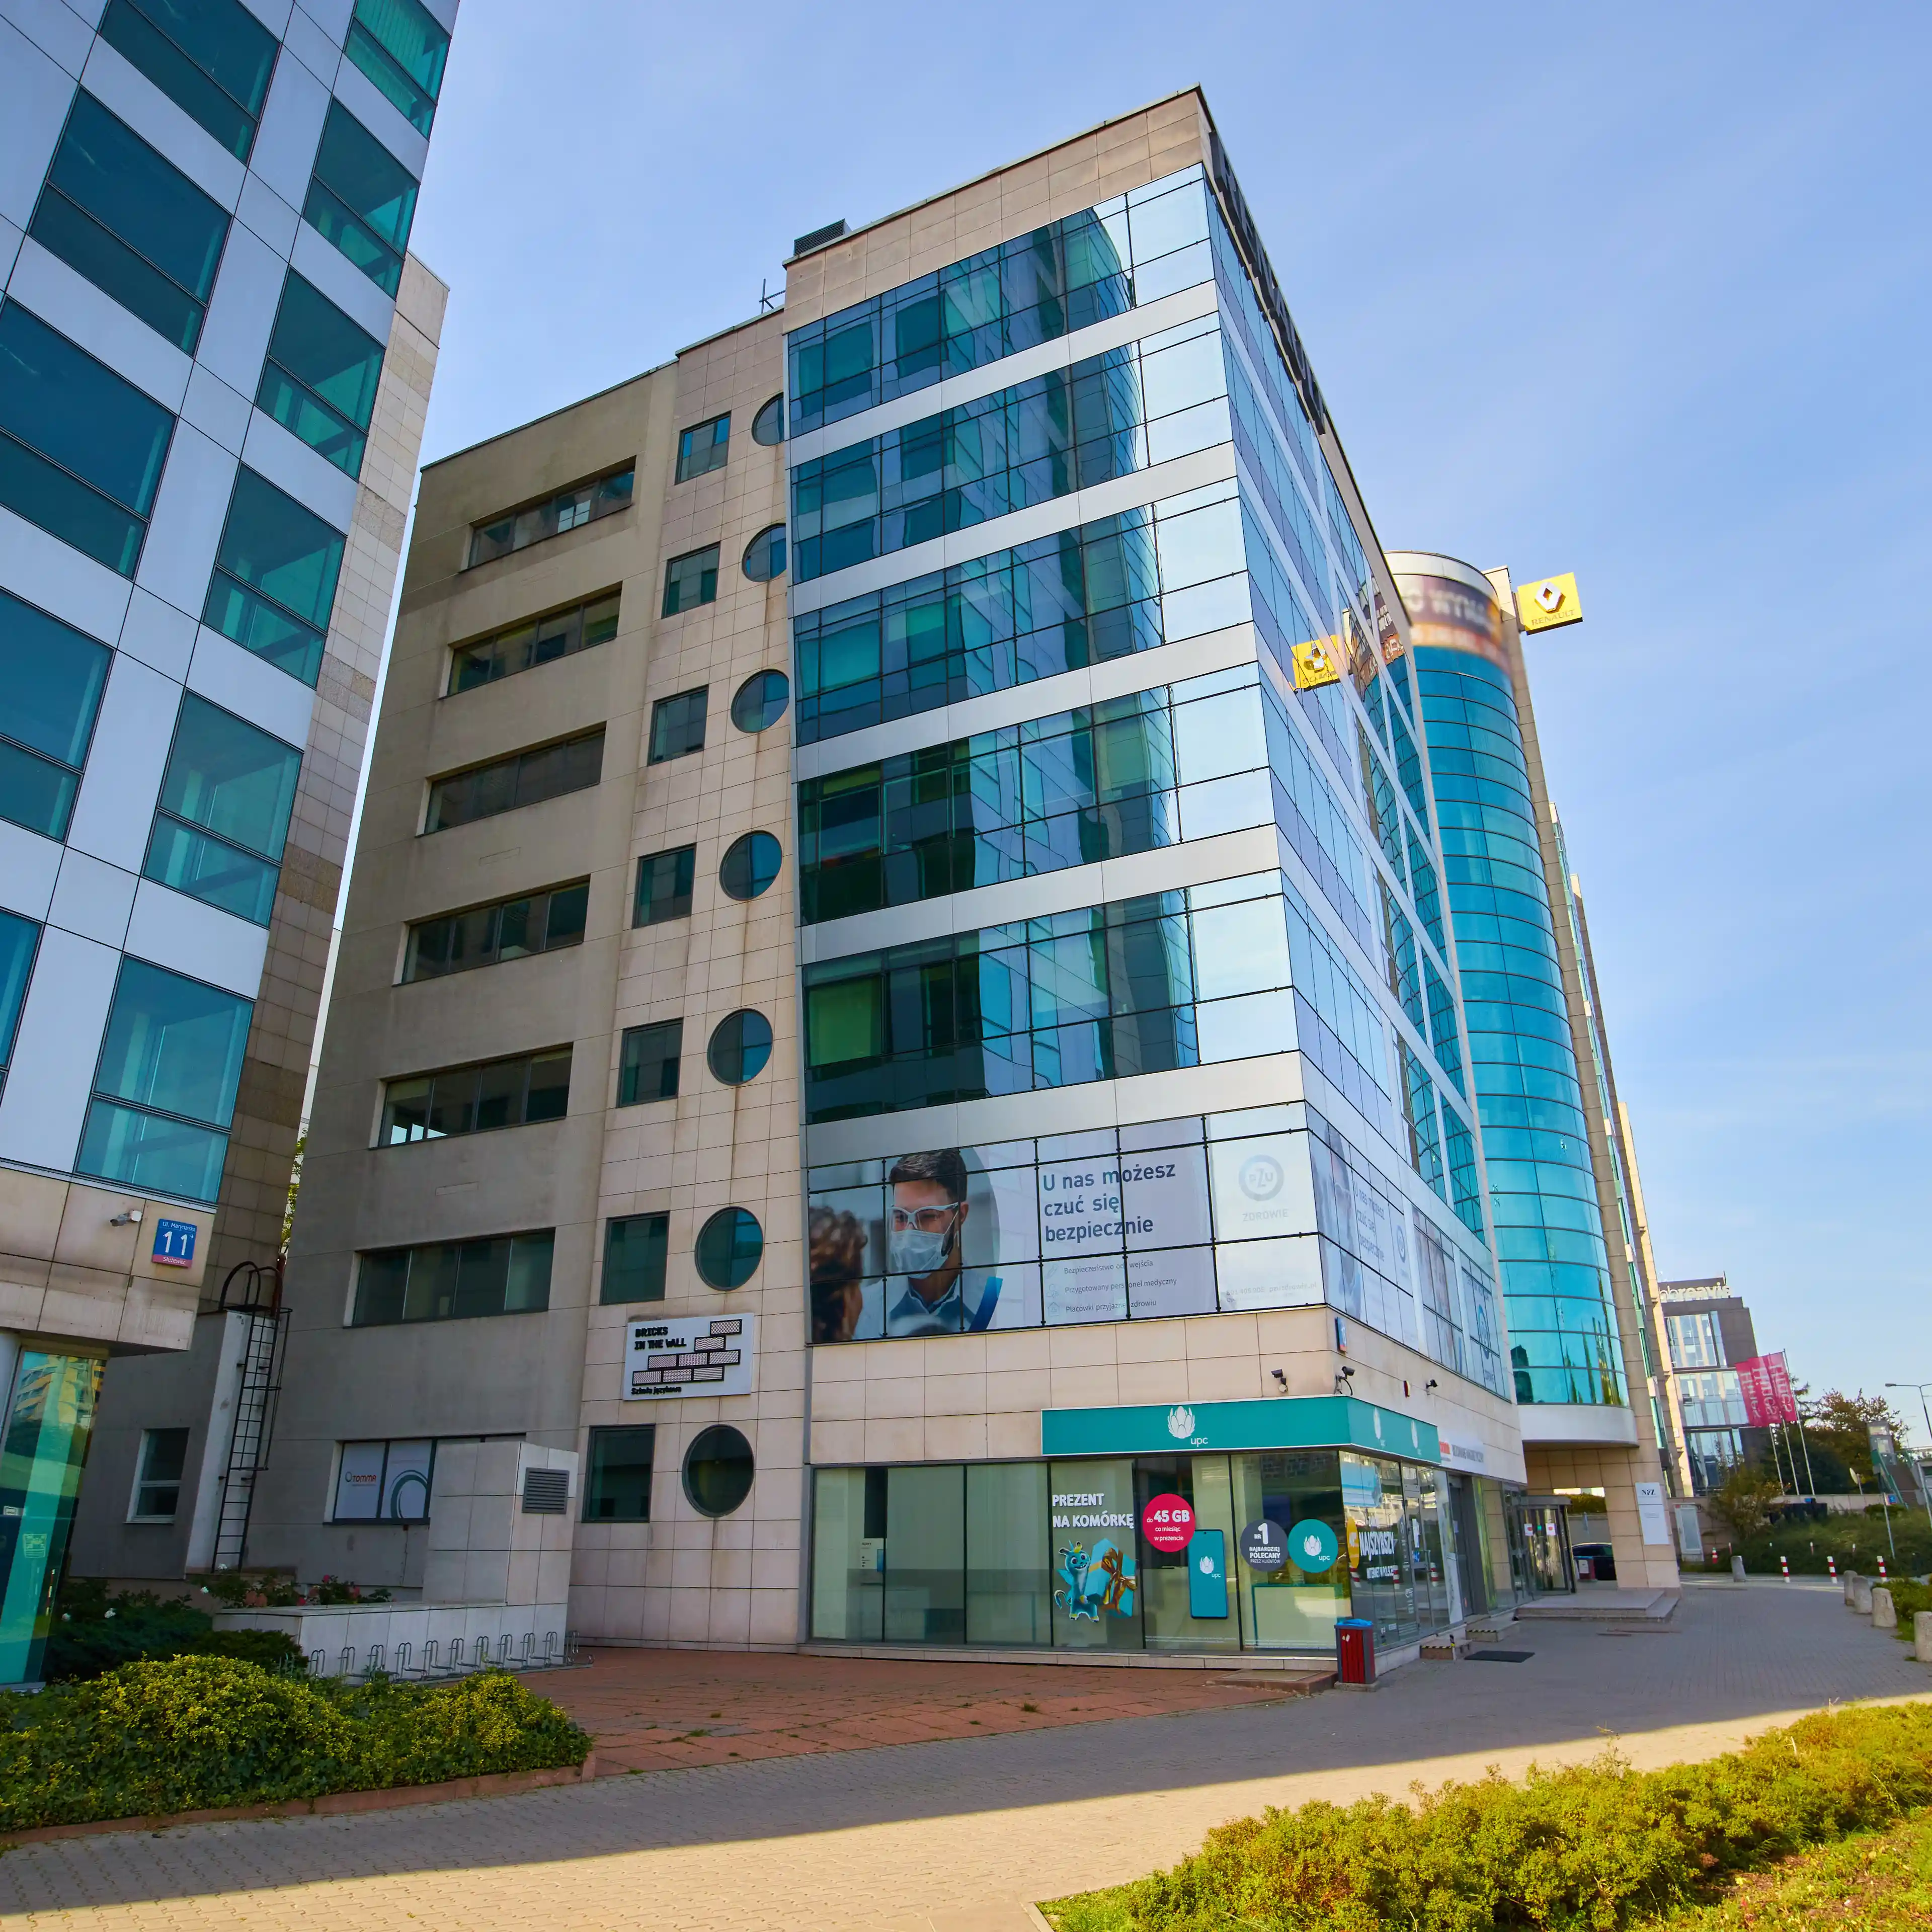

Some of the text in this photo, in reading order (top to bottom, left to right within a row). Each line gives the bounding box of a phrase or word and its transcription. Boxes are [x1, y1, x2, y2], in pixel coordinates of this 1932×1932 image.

[1531, 609, 1575, 625] RENAULT
[1043, 1164, 1176, 1191] U nas możesz
[1044, 1193, 1119, 1217] czuć się
[1242, 1209, 1289, 1222] ZDROWIE
[171, 1223, 196, 1232] Marynarska
[1045, 1216, 1153, 1243] bezpiecznie
[163, 1256, 186, 1265] Służewiec
[1064, 1264, 1113, 1274] Bezpieczeństwo
[1130, 1259, 1153, 1269] wejścia
[1065, 1284, 1109, 1294] Przygotowany
[1144, 1278, 1177, 1287] medyczny
[1095, 1302, 1125, 1311] przyjazne
[1131, 1300, 1156, 1308] zdrowiu
[635, 1326, 669, 1337] BRICKS
[634, 1338, 687, 1350] IN THE WALL
[1190, 1437, 1208, 1447] upc
[1053, 1493, 1104, 1506] PREZENT
[1053, 1510, 1134, 1529] NA KOMÓRKĘ
[1154, 1510, 1170, 1522] 45
[1172, 1510, 1190, 1522] GB
[1258, 1522, 1268, 1545] 1
[1359, 1531, 1395, 1561] NAJSZYBSZY
